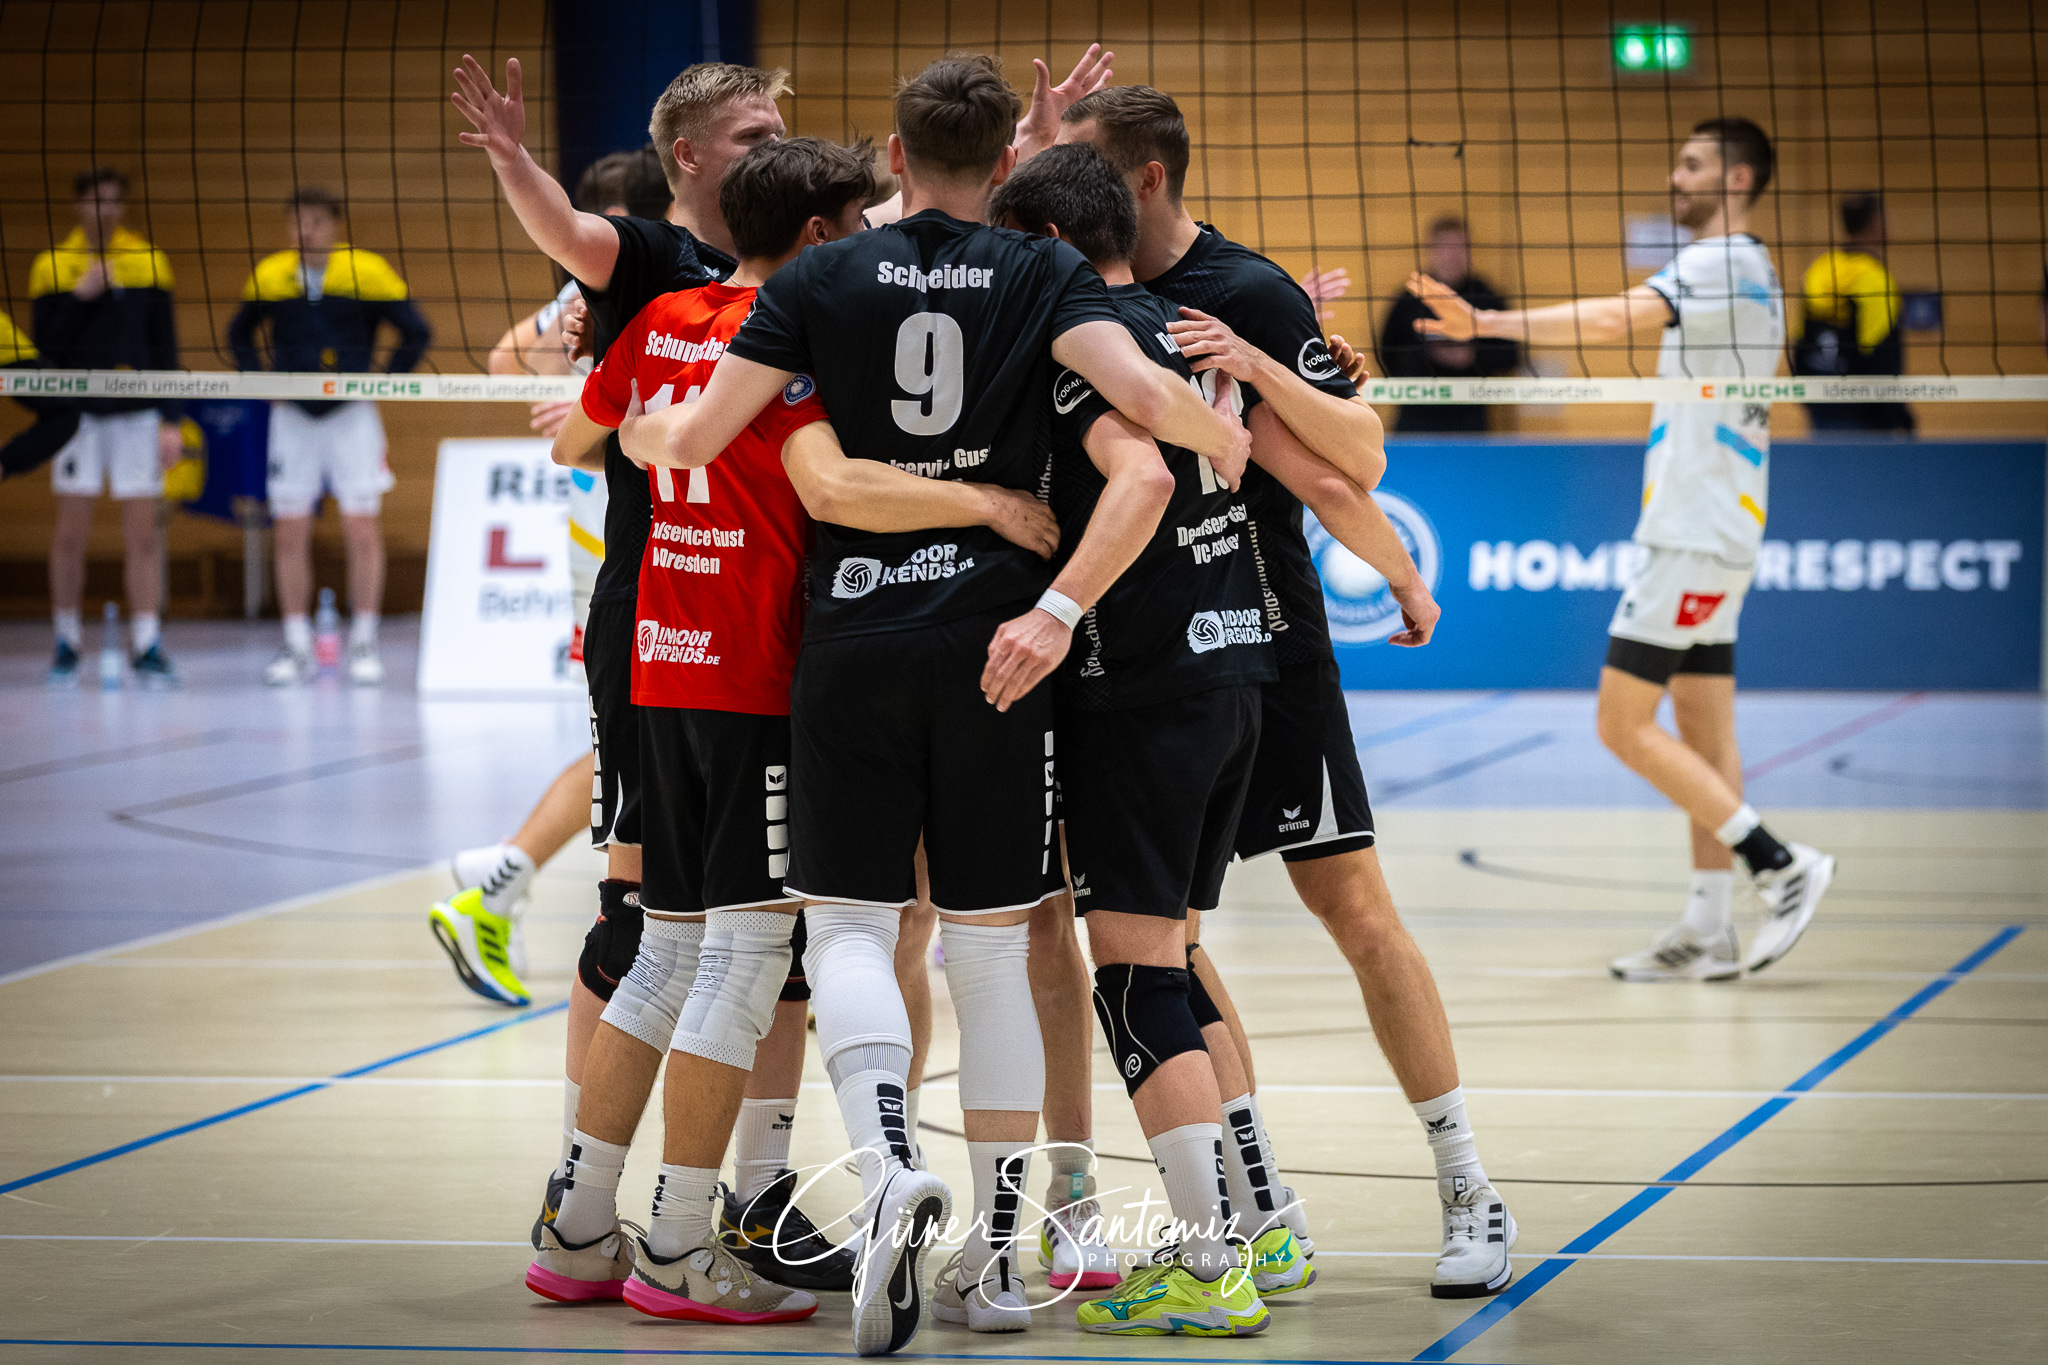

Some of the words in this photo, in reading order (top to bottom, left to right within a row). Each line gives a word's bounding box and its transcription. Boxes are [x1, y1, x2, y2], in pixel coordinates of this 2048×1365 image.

[891, 312, 964, 435] 9
[14, 377, 88, 392] FUCHS
[104, 376, 148, 393] Ideen
[153, 377, 230, 393] umsetzen
[346, 380, 421, 396] FUCHS
[438, 380, 482, 396] Ideen
[488, 380, 566, 397] umsetzen
[1373, 385, 1453, 399] FUCHS
[1468, 384, 1516, 399] Ideen
[1725, 384, 1806, 398] FUCHS
[1822, 384, 1870, 398] Ideen
[1874, 384, 1959, 398] umsetzen
[953, 443, 991, 469] Gus
[711, 527, 746, 548] Gust
[1755, 539, 2023, 592] RESPECT
[1278, 819, 1310, 833] erima
[1427, 1122, 1457, 1135] erima
